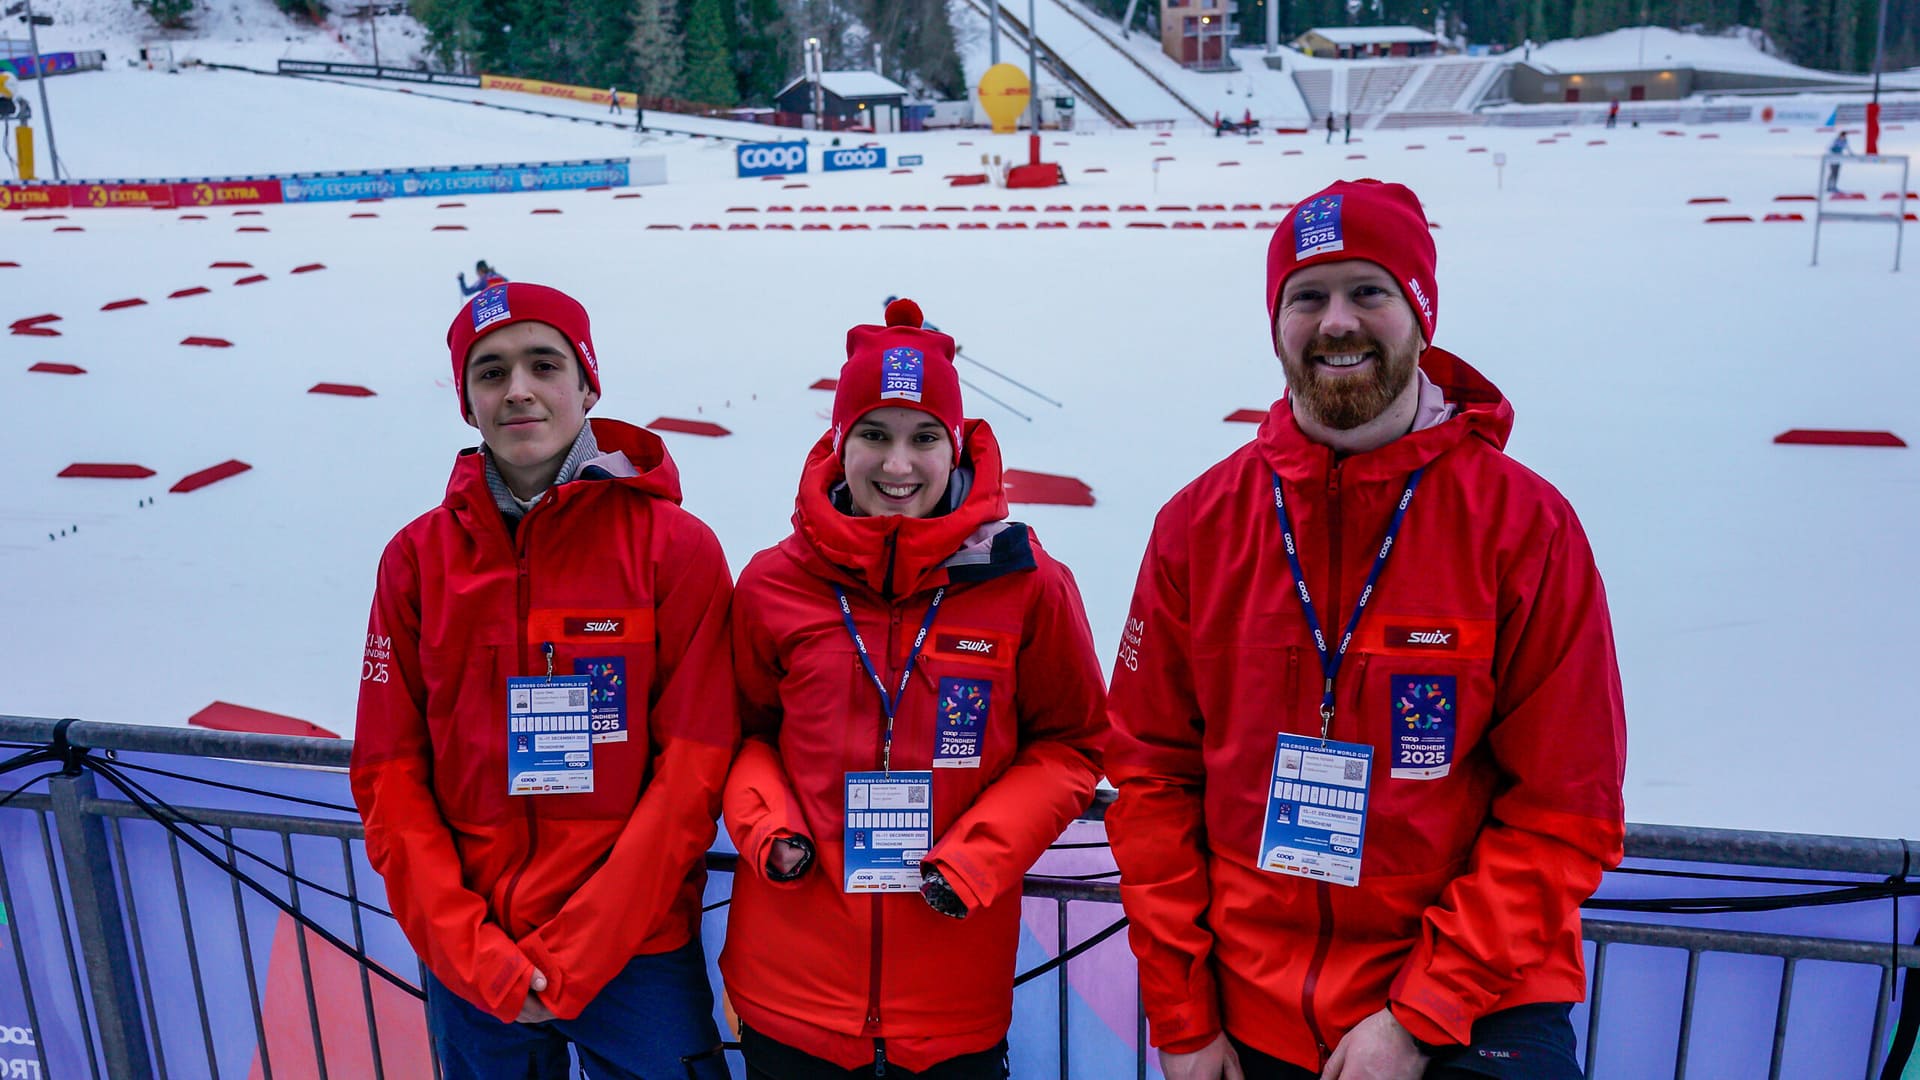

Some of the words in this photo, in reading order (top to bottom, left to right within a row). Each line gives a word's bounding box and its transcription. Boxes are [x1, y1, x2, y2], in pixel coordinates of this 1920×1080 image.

[740, 146, 804, 170] coop
[834, 150, 878, 167] coop
[14, 191, 48, 203] EXTRA
[110, 190, 148, 202] EXTRA
[216, 187, 260, 200] EXTRA
[1302, 231, 1336, 248] 2025
[478, 306, 504, 322] 2025
[888, 380, 917, 390] 2025
[1274, 487, 1283, 508] coop
[1400, 488, 1412, 510] coop
[1284, 532, 1294, 554] coop
[1379, 536, 1392, 558] coop
[932, 588, 944, 606] coop
[1298, 580, 1310, 602] coop
[1360, 585, 1372, 606] coop
[840, 596, 850, 614] coop
[856, 634, 866, 654] coop
[914, 628, 926, 648] coop
[1314, 630, 1326, 651] coop
[1340, 632, 1351, 654] coop
[874, 674, 887, 692] coop
[900, 670, 910, 690] coop
[592, 720, 620, 730] 025
[940, 743, 975, 755] 2025
[1310, 746, 1336, 754] COUNTRY
[1400, 750, 1445, 764] 2025
[1276, 852, 1294, 860] coop
[1333, 845, 1354, 854] coop
